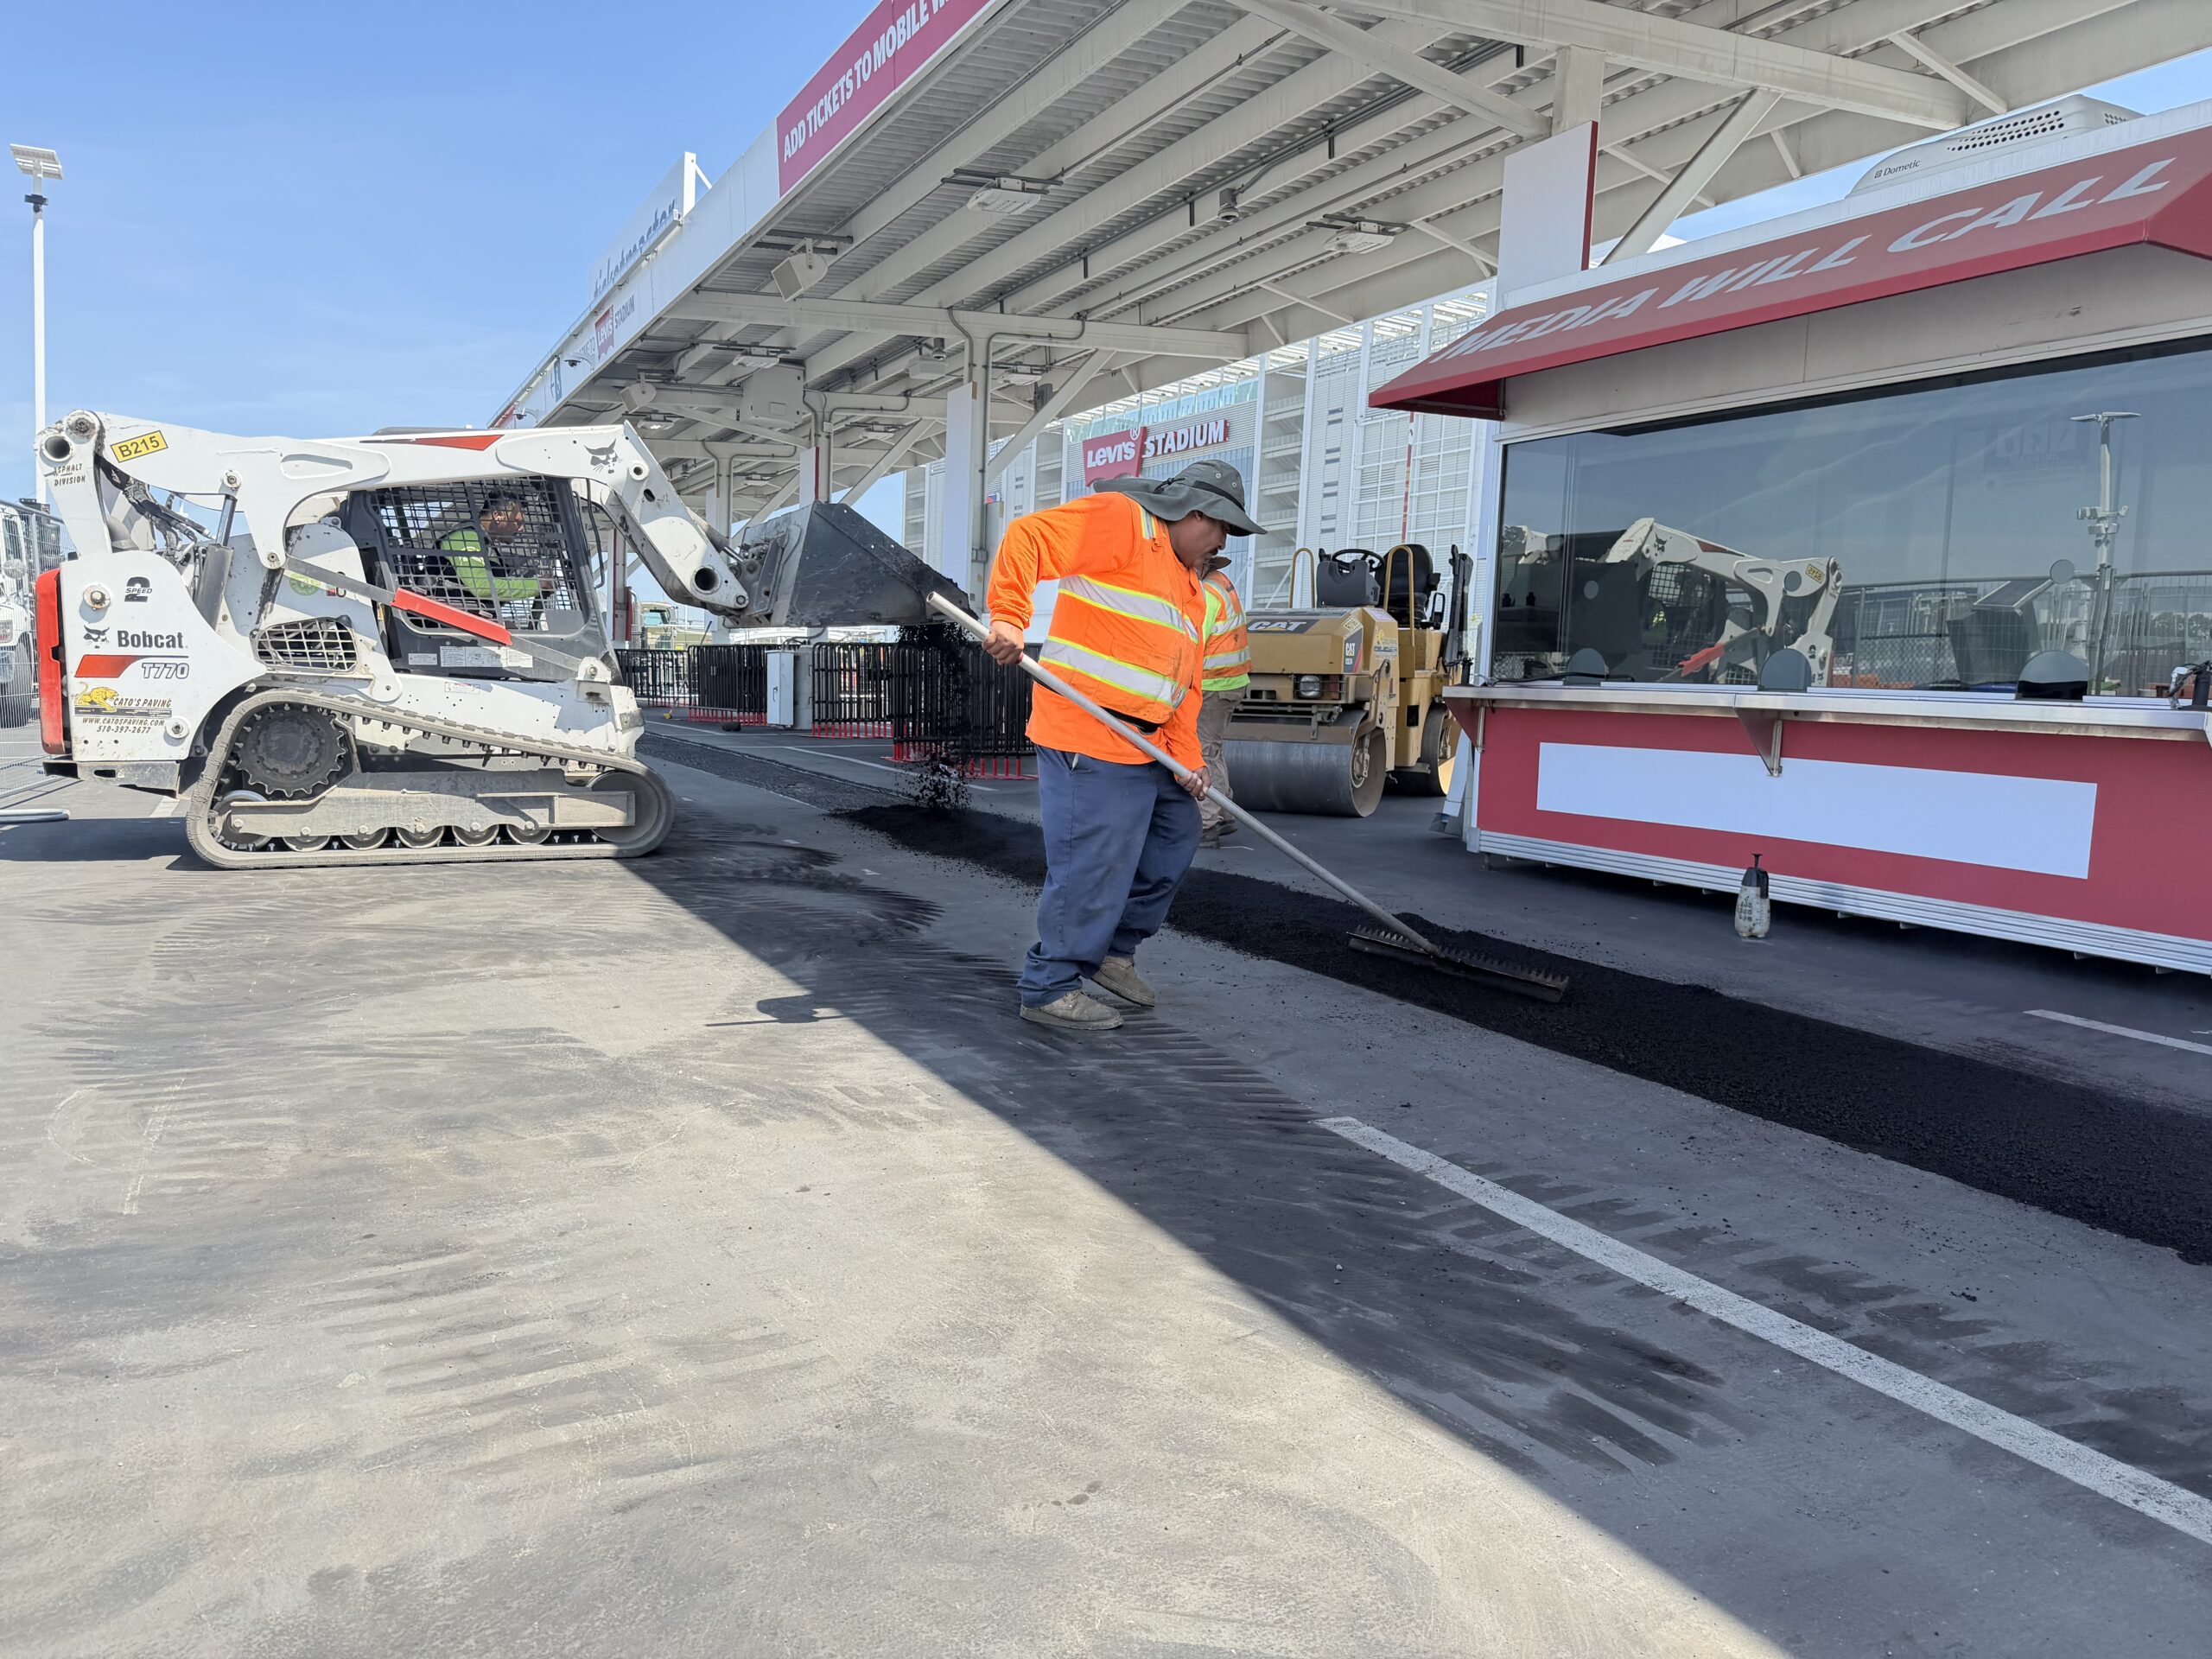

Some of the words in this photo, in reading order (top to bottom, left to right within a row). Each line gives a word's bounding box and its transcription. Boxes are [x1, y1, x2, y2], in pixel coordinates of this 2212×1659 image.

[784, 119, 806, 162] ADD
[806, 68, 854, 139] TICKETS
[855, 50, 872, 90] TO
[873, 0, 929, 73] MOBILE
[1884, 160, 1920, 175] Dometic
[1428, 287, 1659, 364] MEDIA
[1657, 234, 1872, 308] WILL
[1887, 157, 2177, 252] CALL
[614, 295, 635, 329] STADIUM
[118, 436, 159, 457] B215
[1144, 419, 1226, 458] STADIUM
[54, 463, 82, 474] ASPHALT
[54, 475, 86, 486] DIVISION
[124, 576, 150, 602] 2
[1248, 621, 1306, 632] CAT
[118, 630, 184, 648] Bobcat
[1345, 643, 1356, 656] CAT
[142, 663, 189, 679] T770
[143, 698, 172, 708] PAVING
[82, 717, 164, 726] WWW.CATOSPAVING.COM
